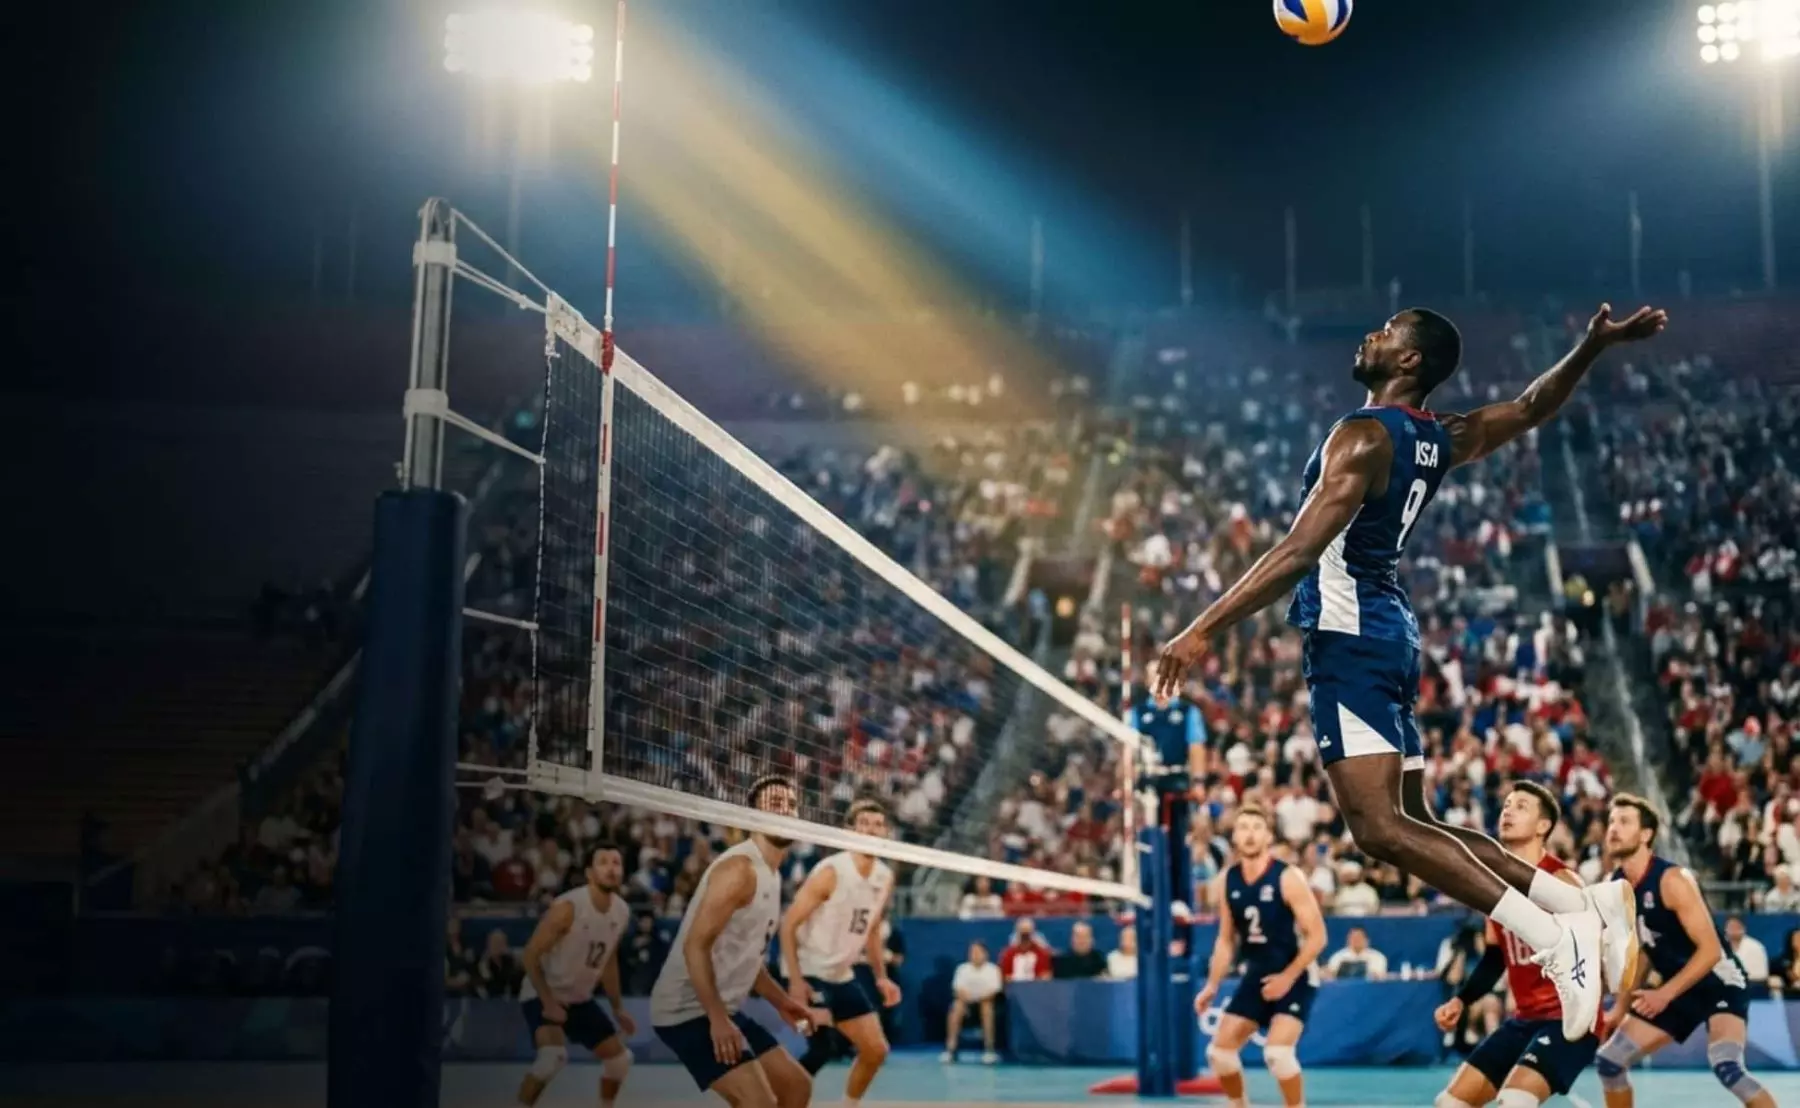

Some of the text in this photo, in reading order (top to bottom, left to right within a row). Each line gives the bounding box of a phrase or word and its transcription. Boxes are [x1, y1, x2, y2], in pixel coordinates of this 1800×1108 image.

[1415, 440, 1438, 468] ISA
[848, 908, 869, 934] 15
[1244, 905, 1263, 935] 2
[585, 940, 606, 969] 12
